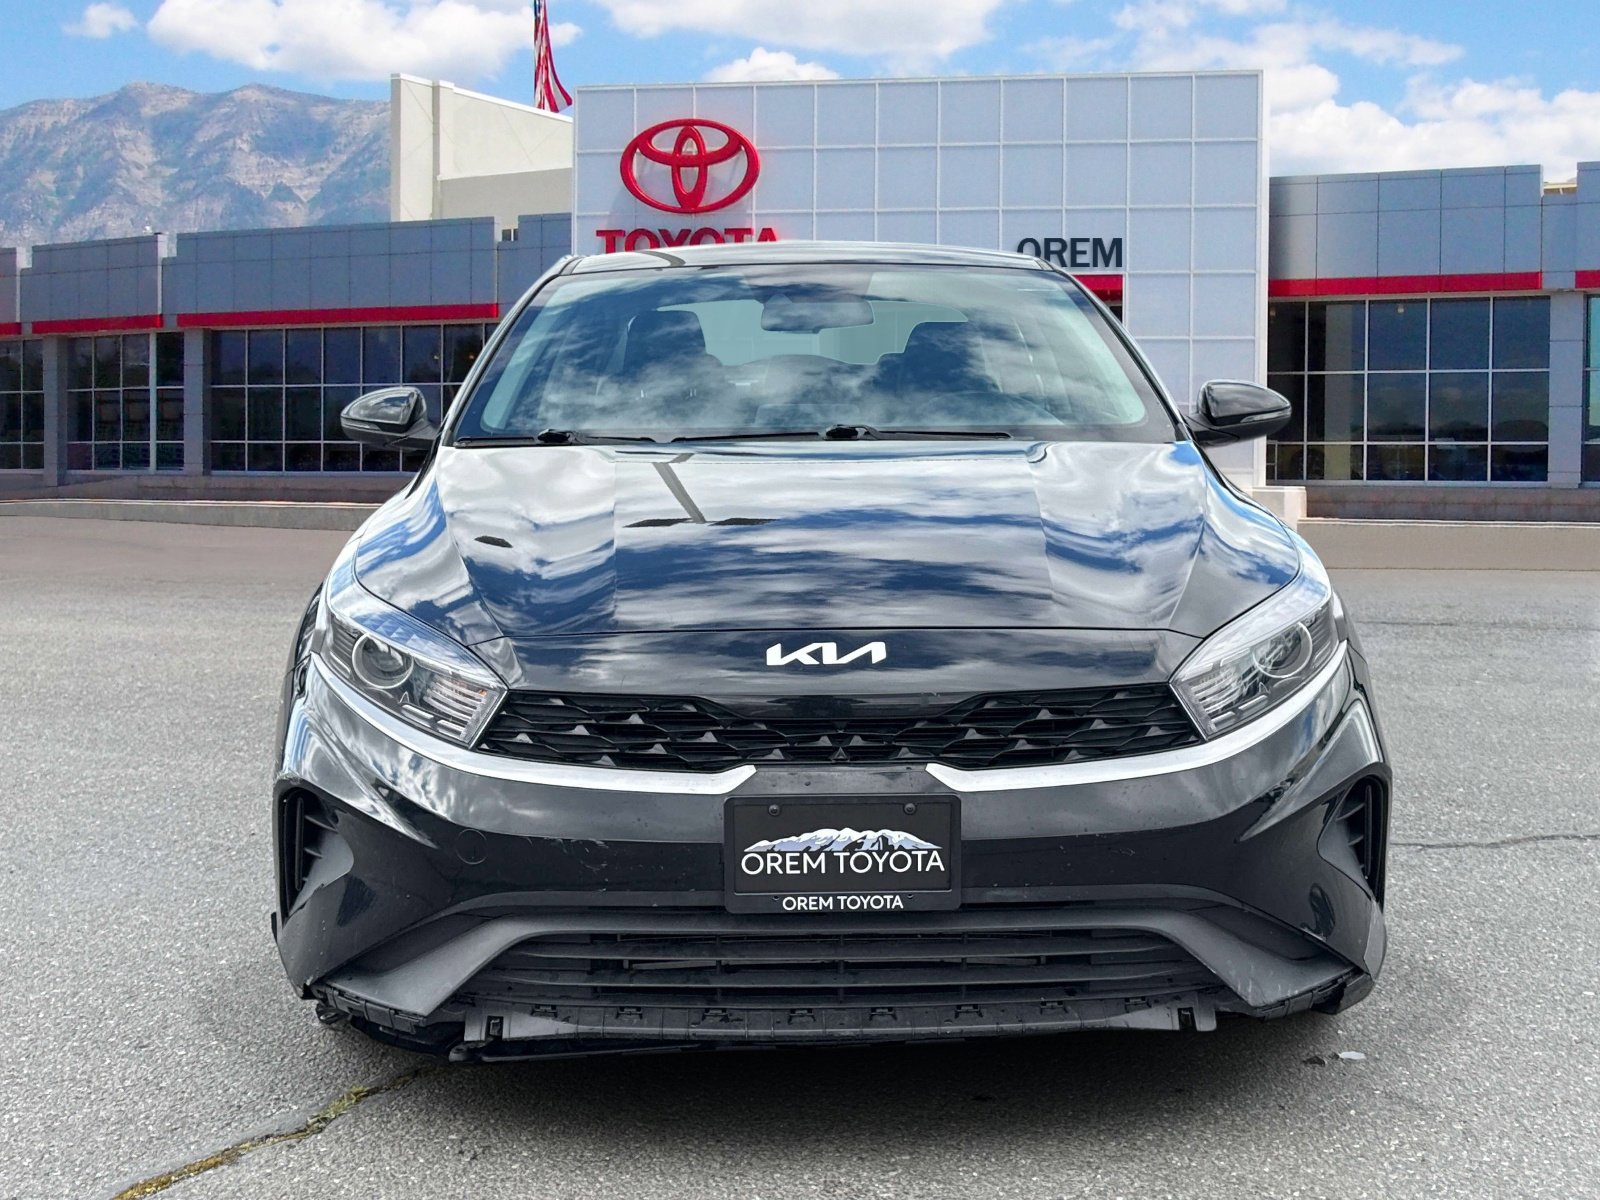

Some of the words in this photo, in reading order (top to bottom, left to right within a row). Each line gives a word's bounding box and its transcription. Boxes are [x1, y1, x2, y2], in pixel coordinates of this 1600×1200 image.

[1017, 238, 1123, 268] OREM
[766, 641, 887, 666] KIA
[741, 852, 826, 875] OREM
[834, 850, 945, 873] TOYOTA
[782, 896, 834, 911] OREM
[836, 895, 904, 910] TOYOTA
